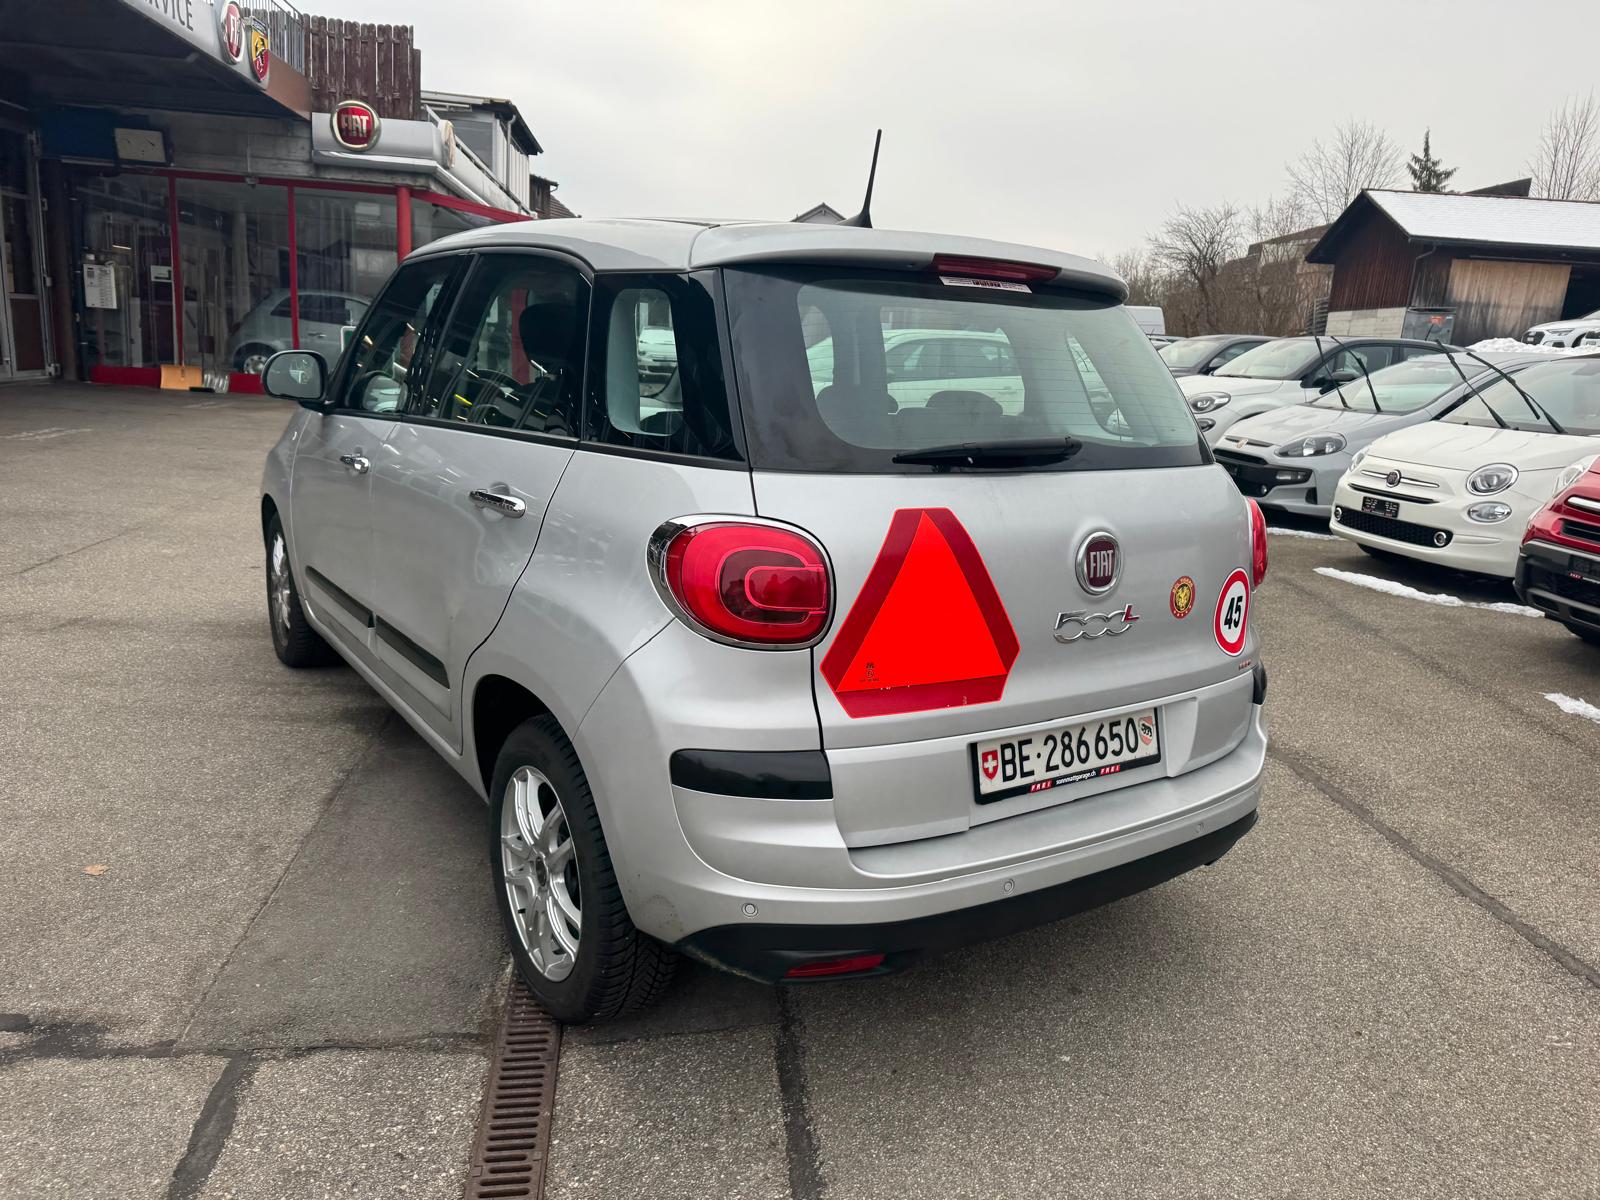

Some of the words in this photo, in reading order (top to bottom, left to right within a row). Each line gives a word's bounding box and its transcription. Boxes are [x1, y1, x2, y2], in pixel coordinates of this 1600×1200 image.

[341, 113, 369, 136] FIAT
[1089, 549, 1114, 578] FIAT
[1223, 595, 1243, 630] 45
